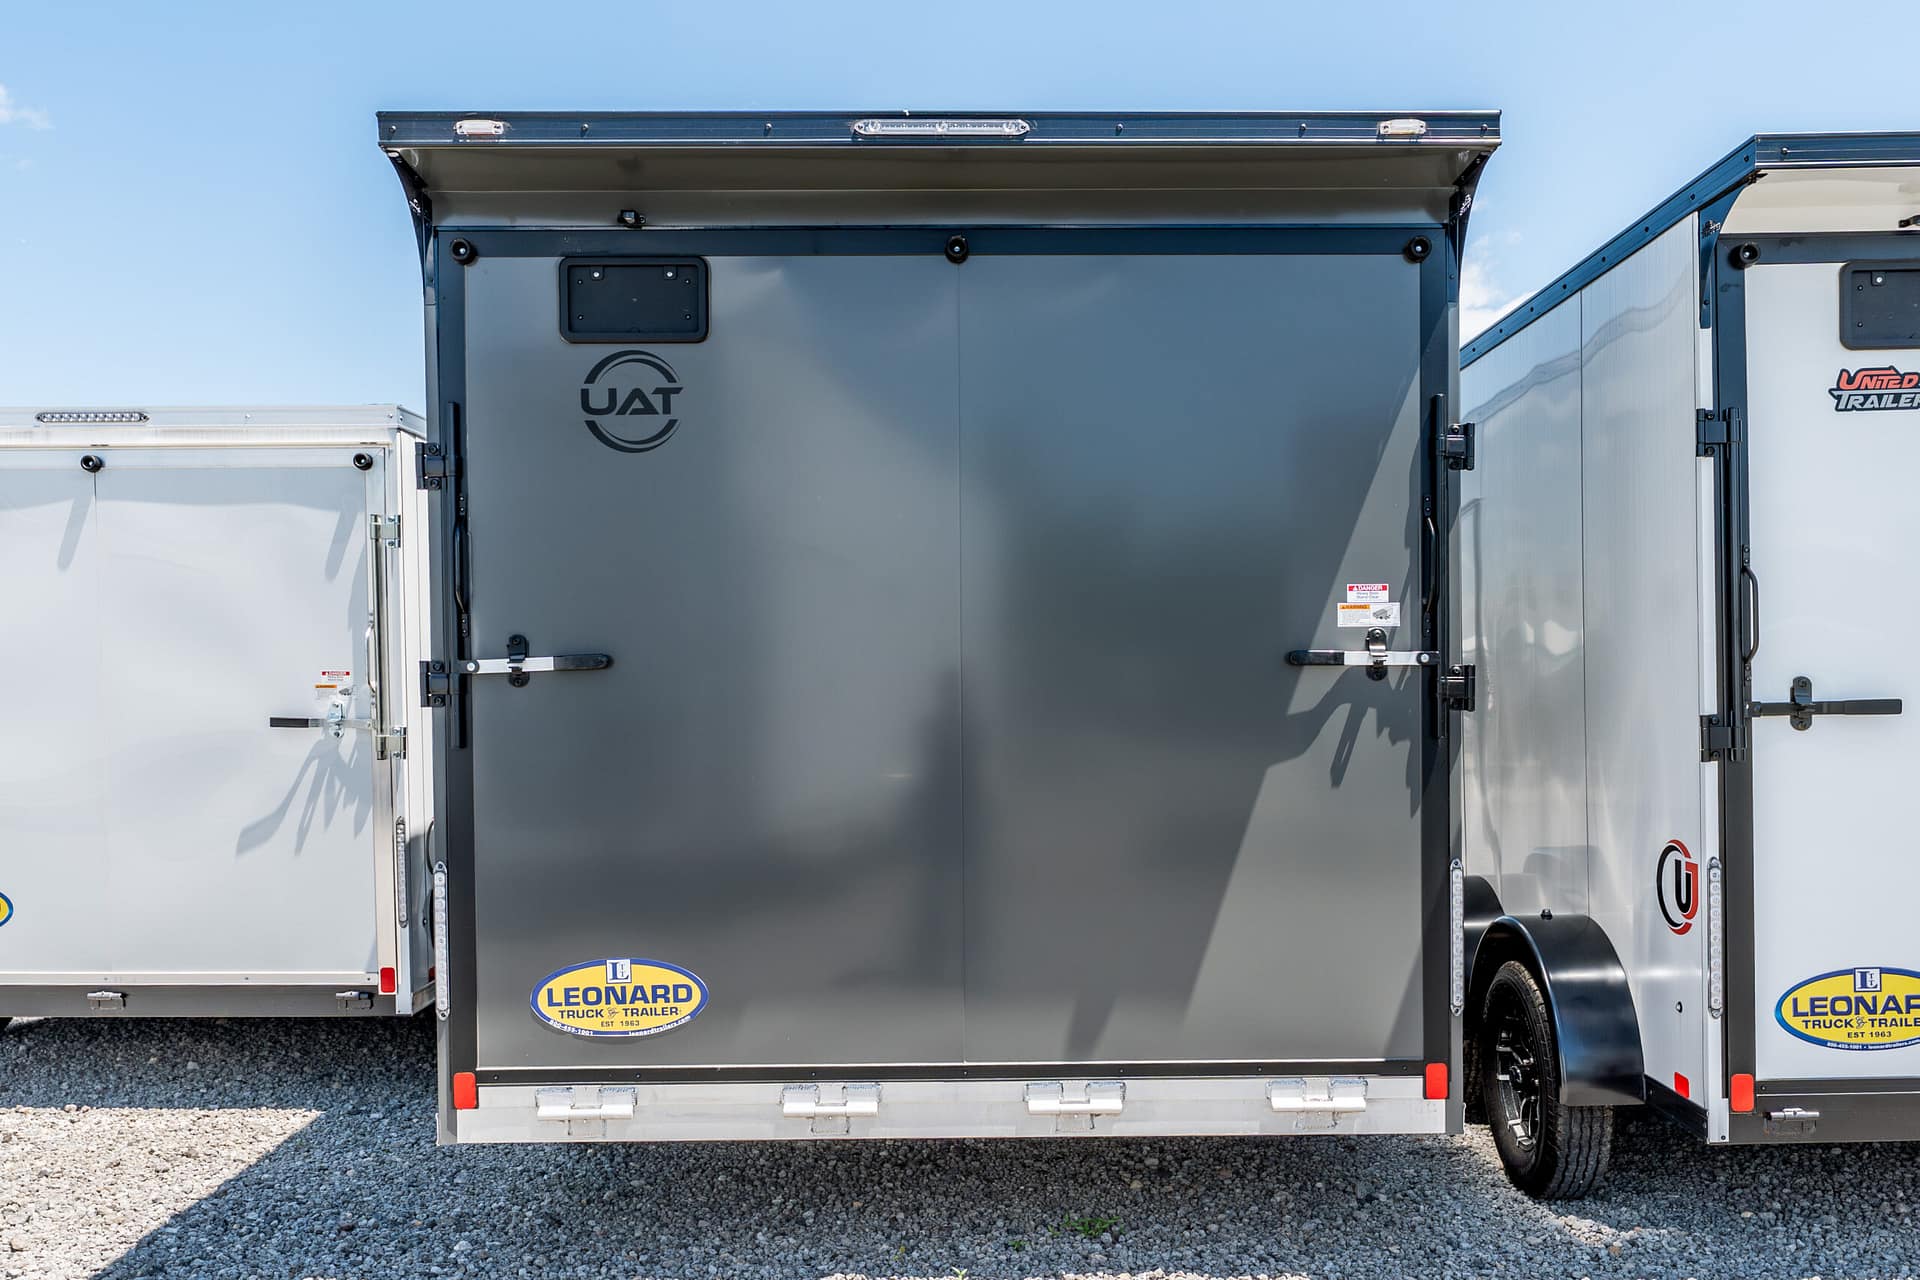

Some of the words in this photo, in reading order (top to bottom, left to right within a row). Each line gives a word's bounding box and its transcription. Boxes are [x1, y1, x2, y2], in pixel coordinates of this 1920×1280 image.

[580, 387, 684, 416] UAT
[547, 984, 693, 1007] LEONARD
[558, 1009, 604, 1019] TRUCK
[622, 1007, 679, 1017] TRAILER
[1802, 1019, 1854, 1029] TRUCK
